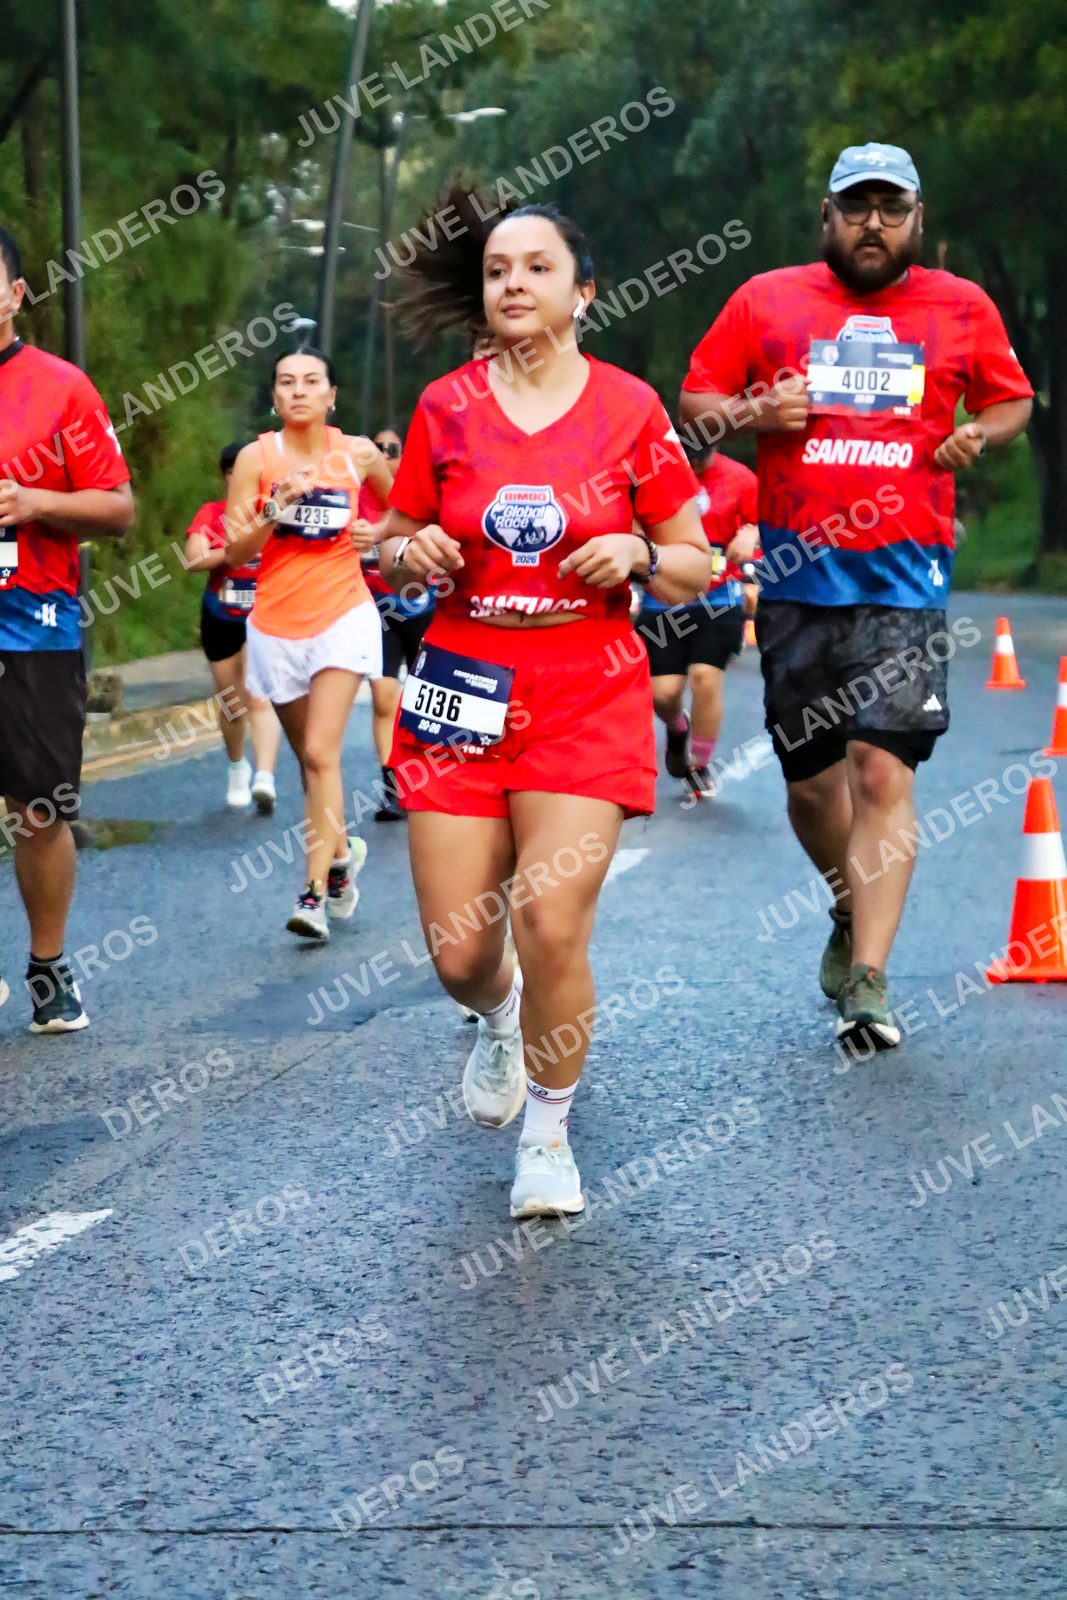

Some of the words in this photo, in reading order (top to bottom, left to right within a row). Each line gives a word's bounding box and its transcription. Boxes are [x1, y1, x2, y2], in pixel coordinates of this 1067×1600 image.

[842, 370, 891, 391] 4002
[802, 438, 913, 469] SANTIAGO
[504, 492, 547, 501] BIMBO
[294, 507, 330, 525] 4235
[503, 505, 546, 518] Global
[495, 517, 529, 529] Race
[515, 554, 537, 564] 2026
[414, 683, 462, 722] 5136
